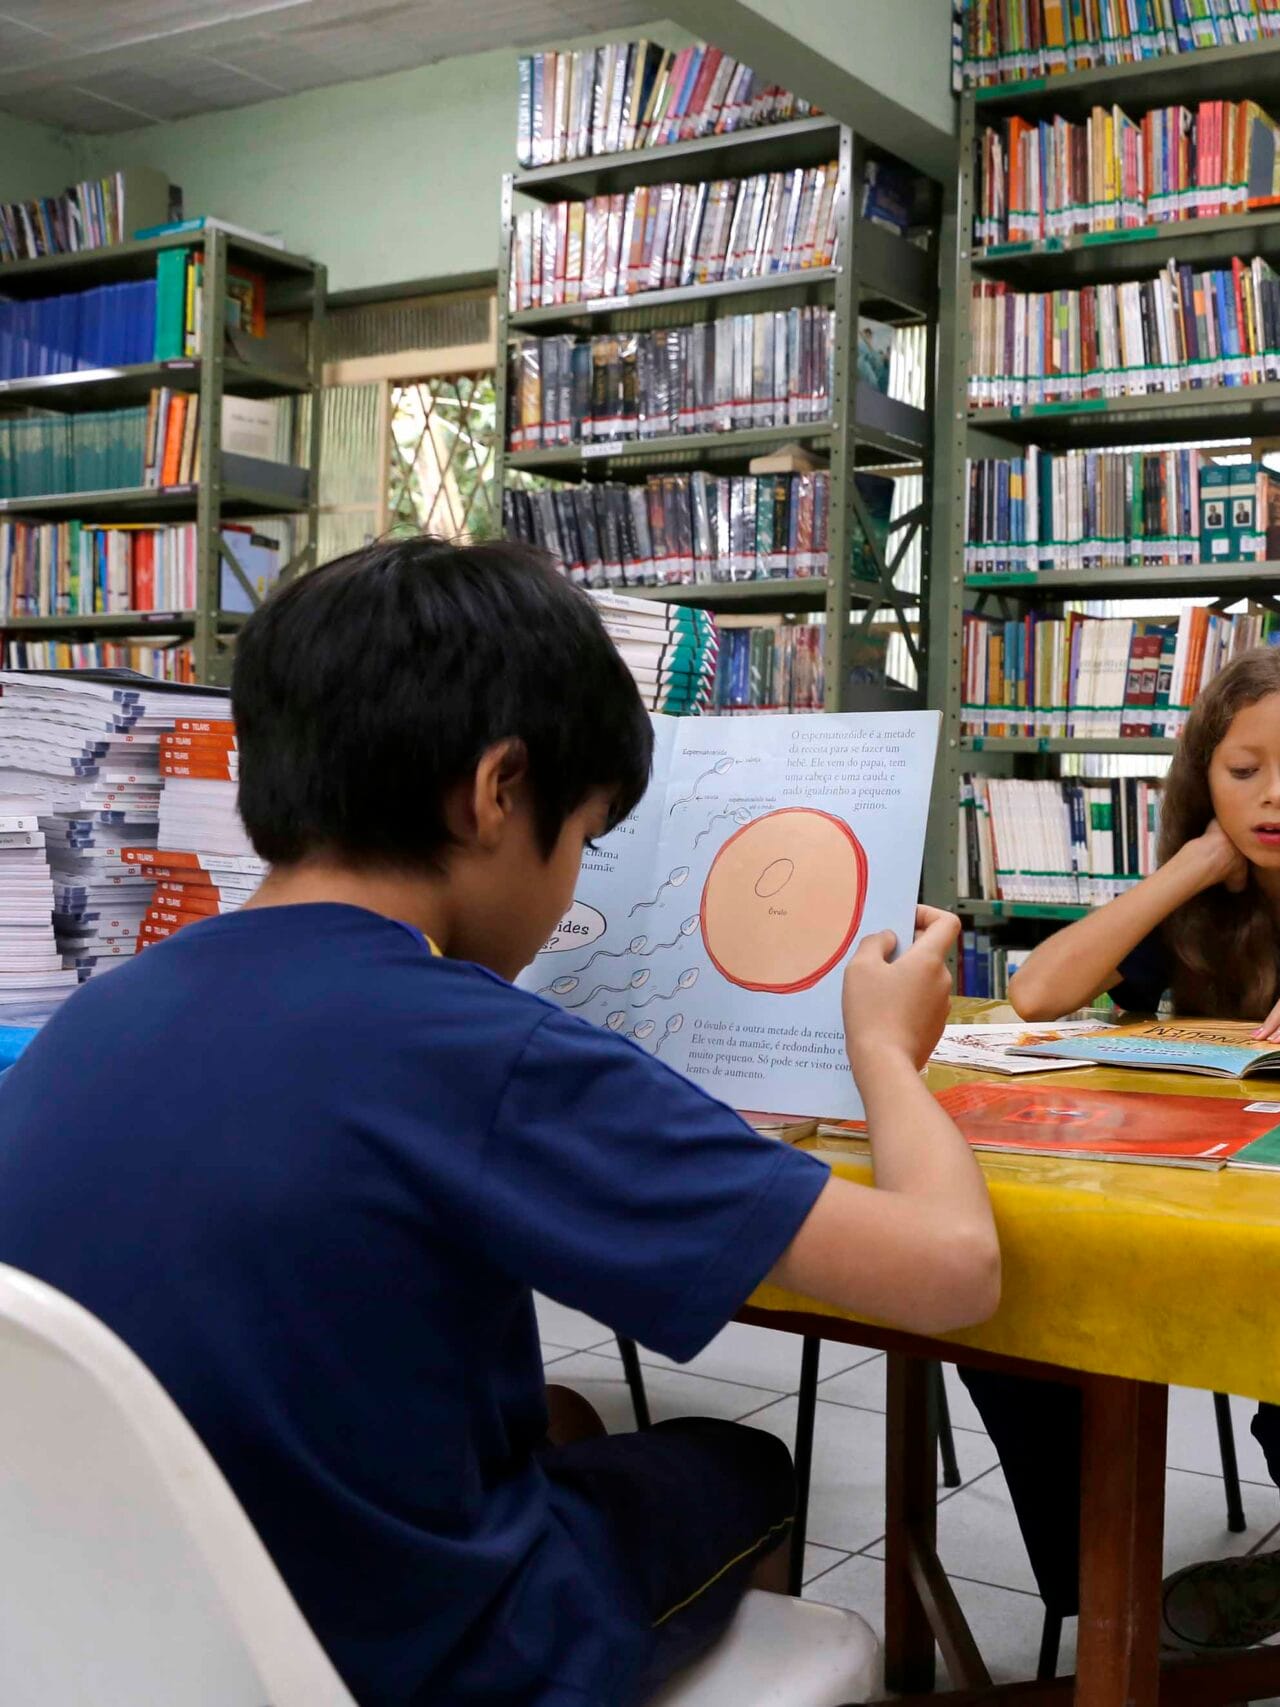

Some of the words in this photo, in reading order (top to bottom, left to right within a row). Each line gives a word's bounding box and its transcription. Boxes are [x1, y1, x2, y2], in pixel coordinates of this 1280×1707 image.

[792, 730, 800, 739] O
[885, 729, 915, 738] metade
[801, 744, 828, 753] receita
[830, 746, 848, 755] para
[862, 744, 883, 752] fazer
[811, 758, 824, 767] Ele
[848, 758, 858, 767] do
[860, 760, 886, 769] papai,
[889, 759, 906, 767] tem
[805, 772, 831, 783] cabeça
[862, 771, 888, 780] cauda
[804, 786, 849, 797] igualzinho
[858, 788, 901, 797] pequenos
[557, 921, 589, 935] ides
[694, 1019, 702, 1029] O
[704, 1019, 726, 1030] óvulo
[729, 1021, 734, 1031] é
[743, 1024, 765, 1034] outra
[767, 1025, 798, 1036] metade
[801, 1028, 811, 1038] da
[815, 1030, 844, 1040] receita
[692, 1033, 702, 1043] Ele
[707, 1037, 724, 1045] vem
[727, 1036, 736, 1046] da
[740, 1039, 773, 1050] mamãe,
[776, 1039, 780, 1050] é
[782, 1041, 836, 1054] redondinho
[689, 1050, 713, 1059] muito
[715, 1052, 754, 1064] pequeno.
[758, 1054, 769, 1063] Só
[771, 1055, 793, 1068] pode
[795, 1058, 808, 1068] ser
[811, 1058, 832, 1070] visto
[686, 1063, 710, 1074] lentes
[713, 1065, 722, 1076] de
[725, 1069, 766, 1079] aumento.
